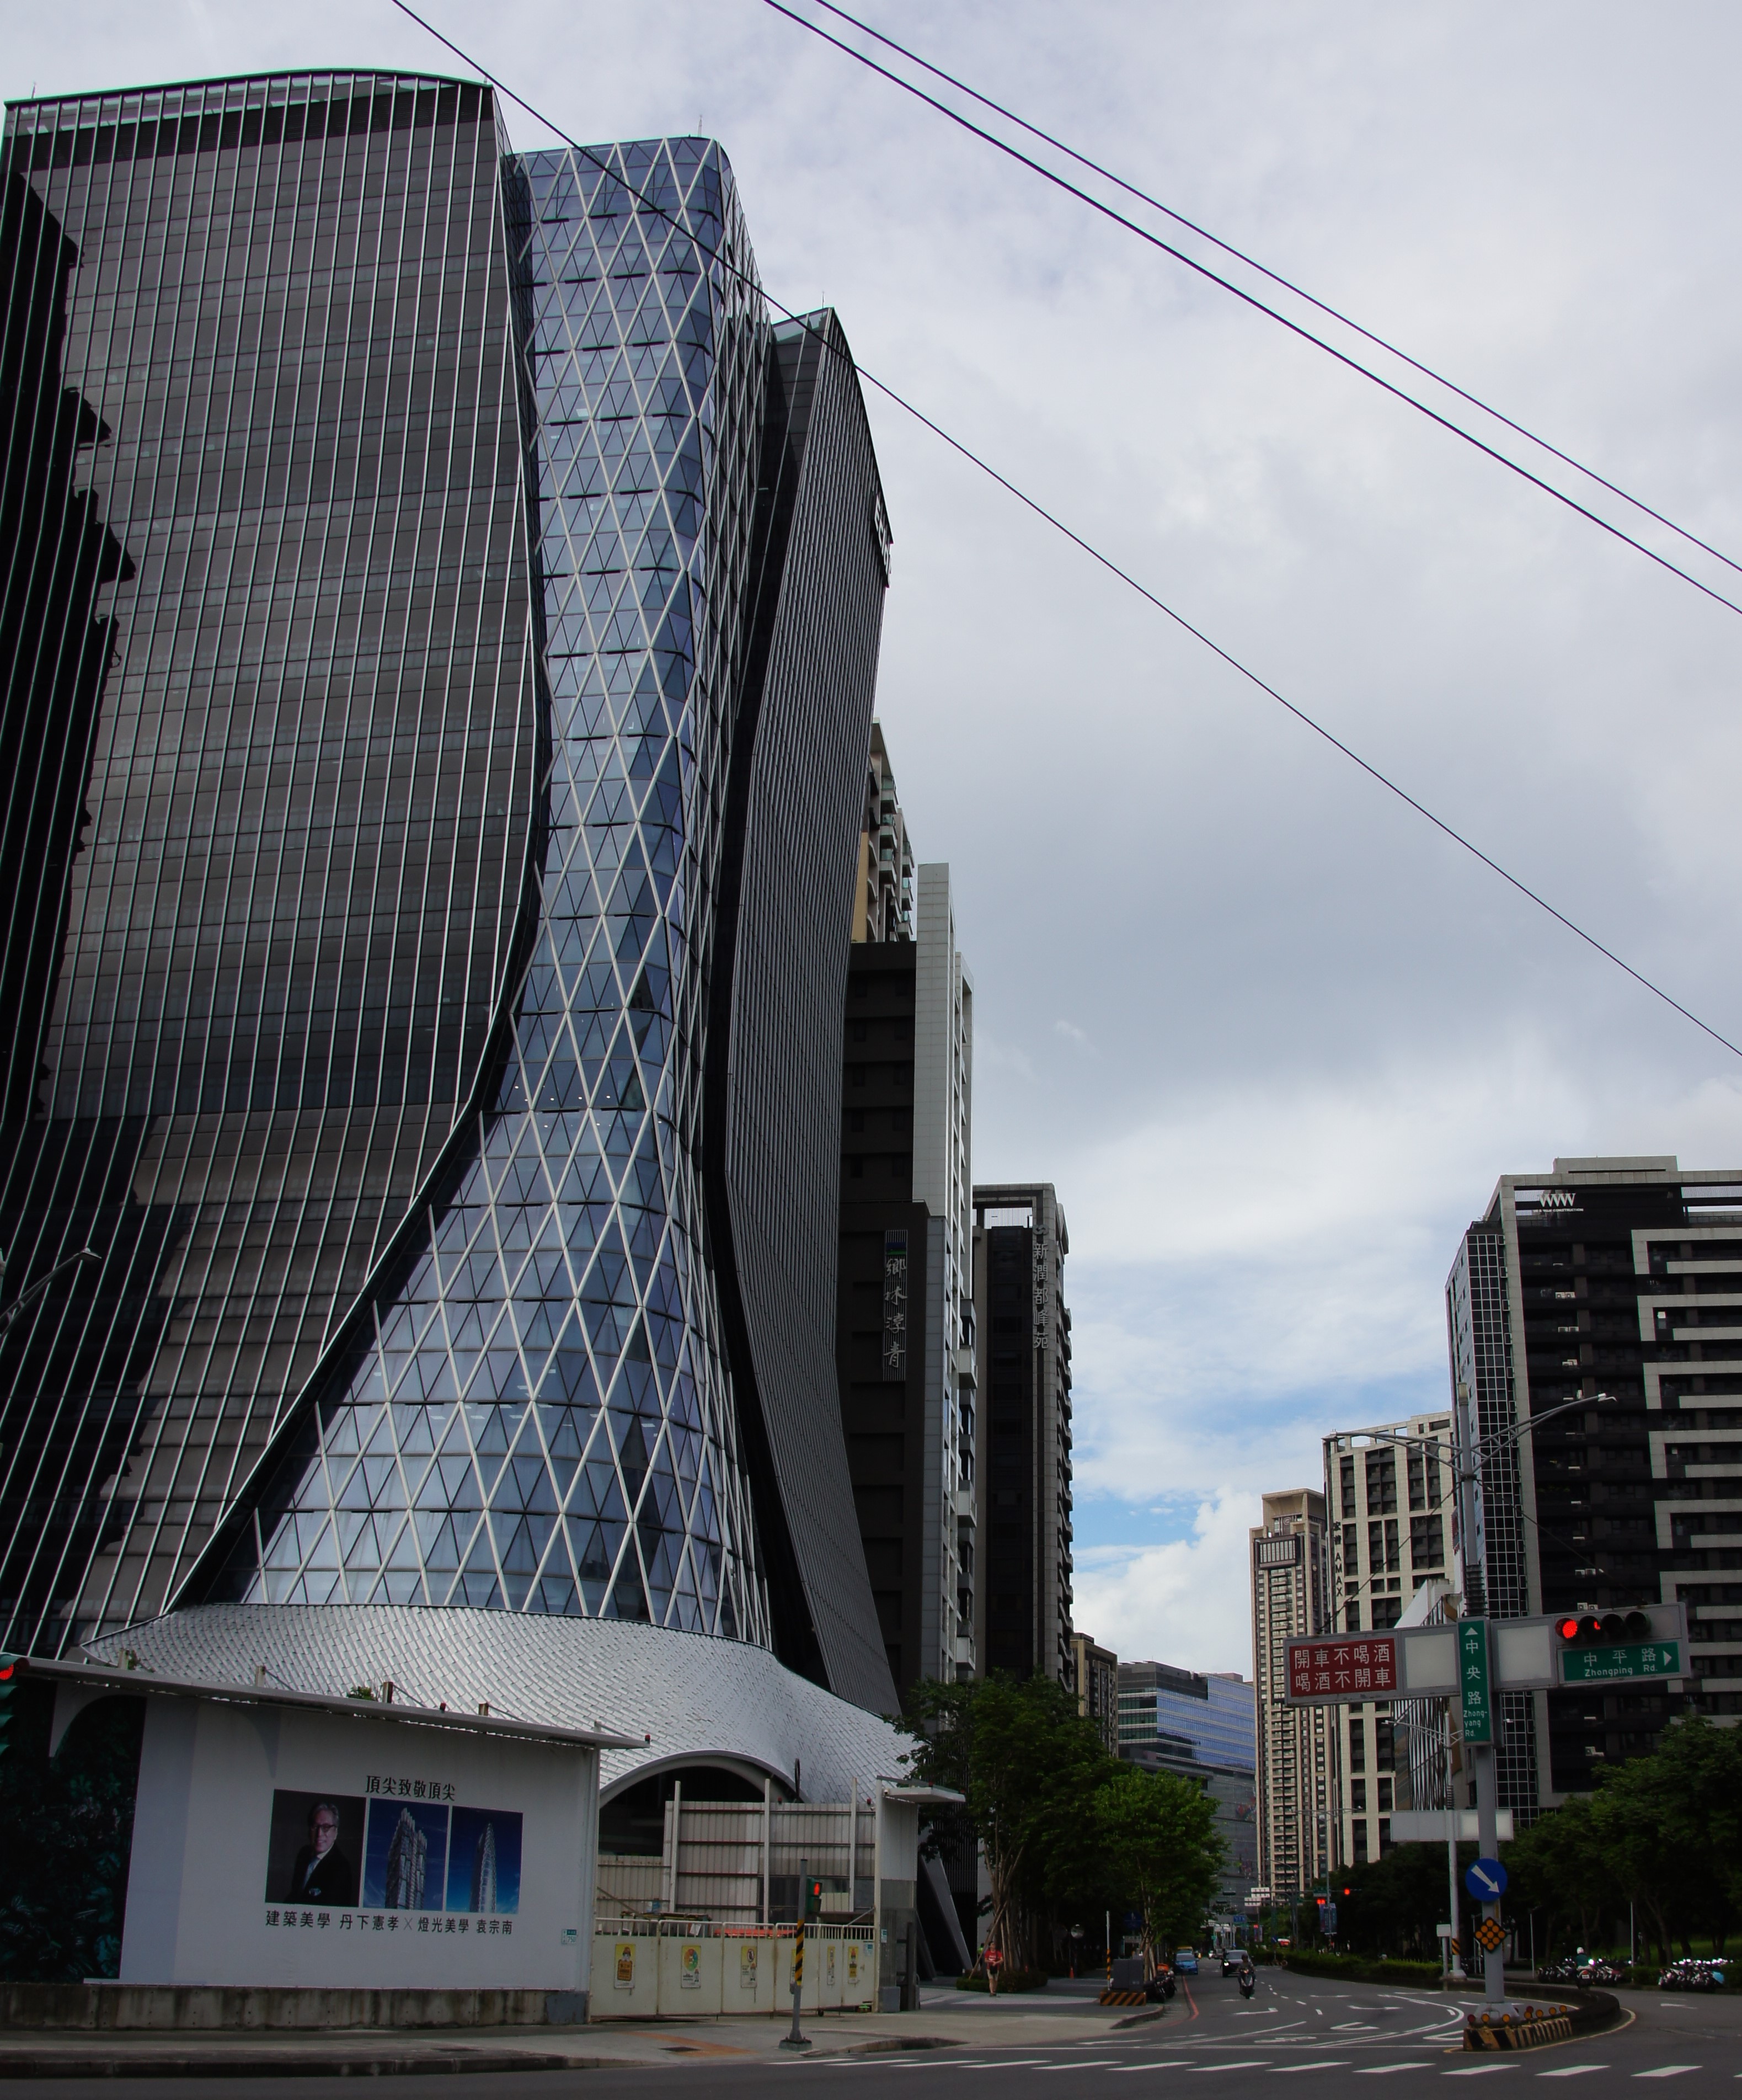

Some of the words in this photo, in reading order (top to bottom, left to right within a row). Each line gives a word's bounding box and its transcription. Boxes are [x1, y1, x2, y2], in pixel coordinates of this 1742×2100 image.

[1033, 1243, 1048, 1349] 新潤都峰苑
[1295, 1644, 1390, 1669] 開車不喝酒
[1584, 1648, 1656, 1667] 中平路
[1296, 1667, 1391, 1692] 喝酒不開車
[1466, 1639, 1482, 1705] 中央路
[1585, 1667, 1633, 1677] Zhongping
[1463, 1710, 1488, 1718] Zhong-
[366, 1776, 455, 1801] 頂尖致敬頂尖
[265, 1910, 330, 1928] 建築美學
[340, 1914, 399, 1931] 丹下憲孝
[418, 1917, 469, 1933] 燈光美學
[477, 1918, 512, 1935] 袁宗南
